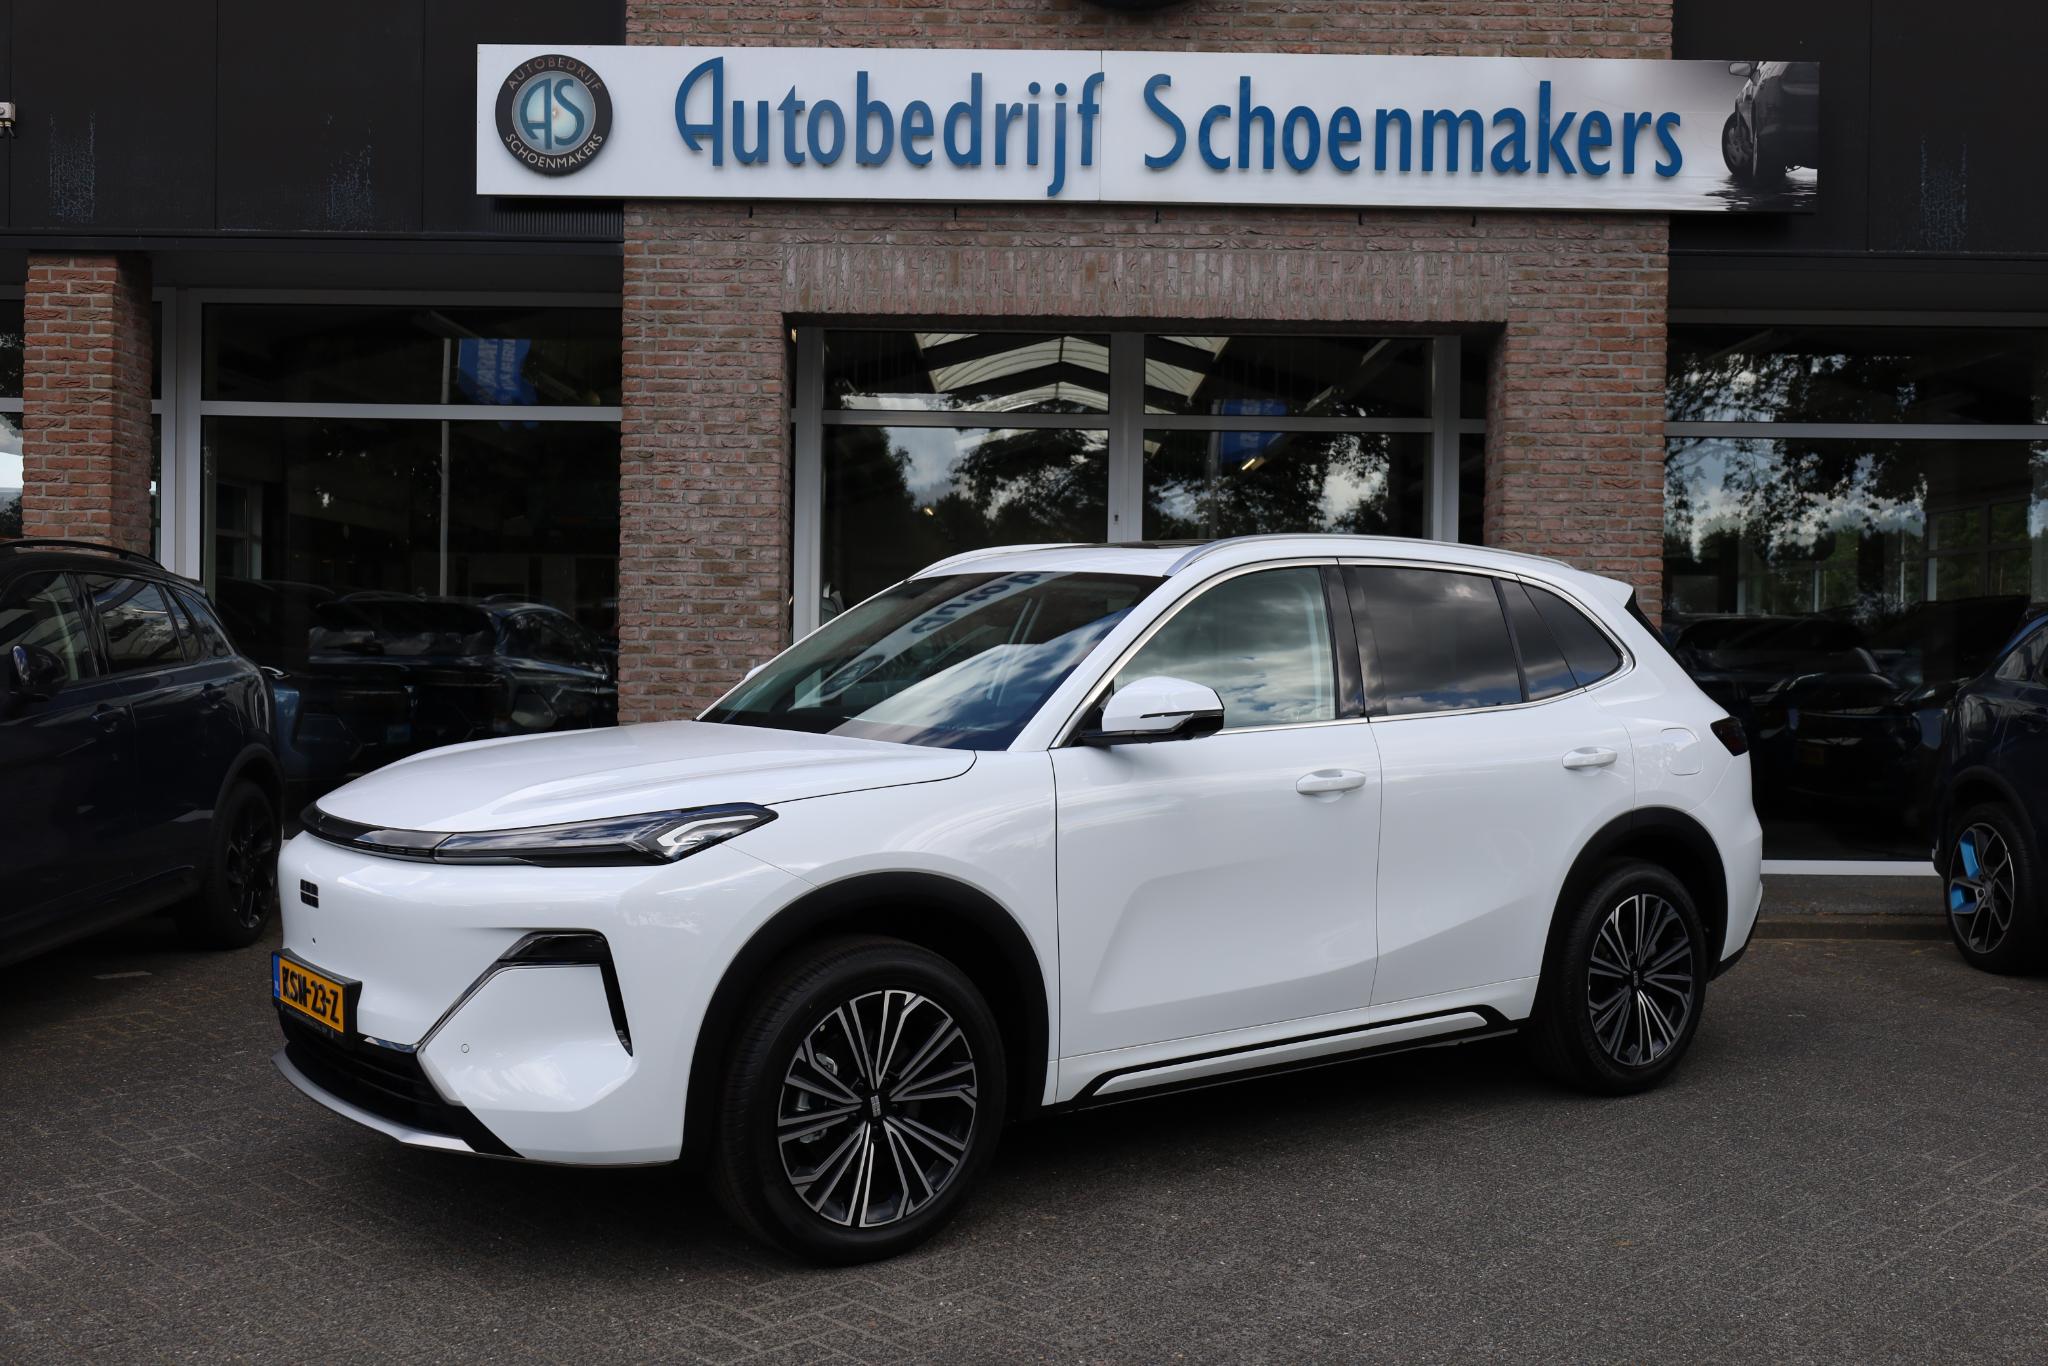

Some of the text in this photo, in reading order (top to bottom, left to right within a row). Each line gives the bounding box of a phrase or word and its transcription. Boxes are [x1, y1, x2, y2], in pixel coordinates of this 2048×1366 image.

[508, 57, 602, 91] AUTOBEDRIJF
[520, 78, 585, 150] AS
[676, 57, 1681, 197] Autobedrijf Schoenmakers
[506, 134, 603, 169] SCHOENMAKERS
